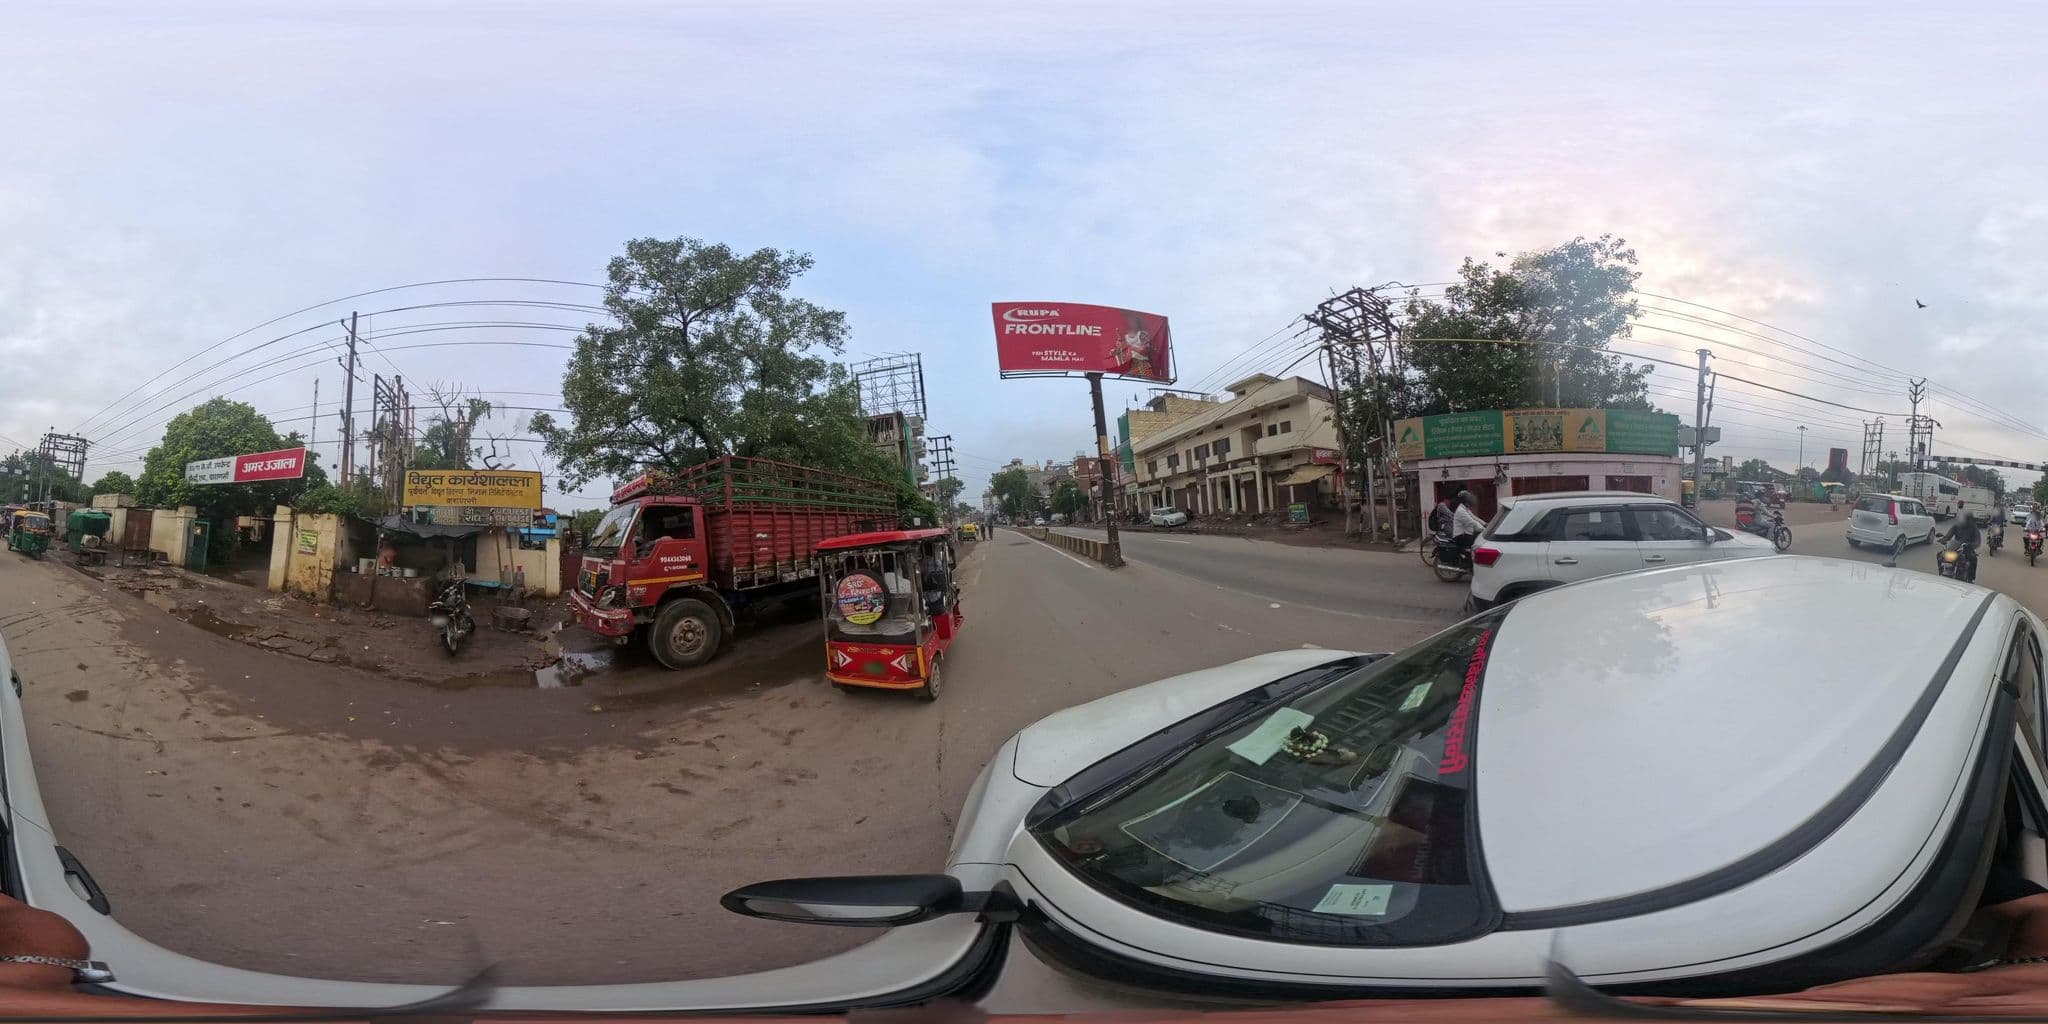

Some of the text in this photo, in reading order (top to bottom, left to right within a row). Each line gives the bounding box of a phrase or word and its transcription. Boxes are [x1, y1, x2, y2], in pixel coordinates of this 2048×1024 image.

[1017, 309, 1060, 317] RUPA
[1005, 324, 1102, 337] FRONTLINE
[242, 457, 296, 473] अमर उजाला
[408, 472, 445, 488] विद्युत
